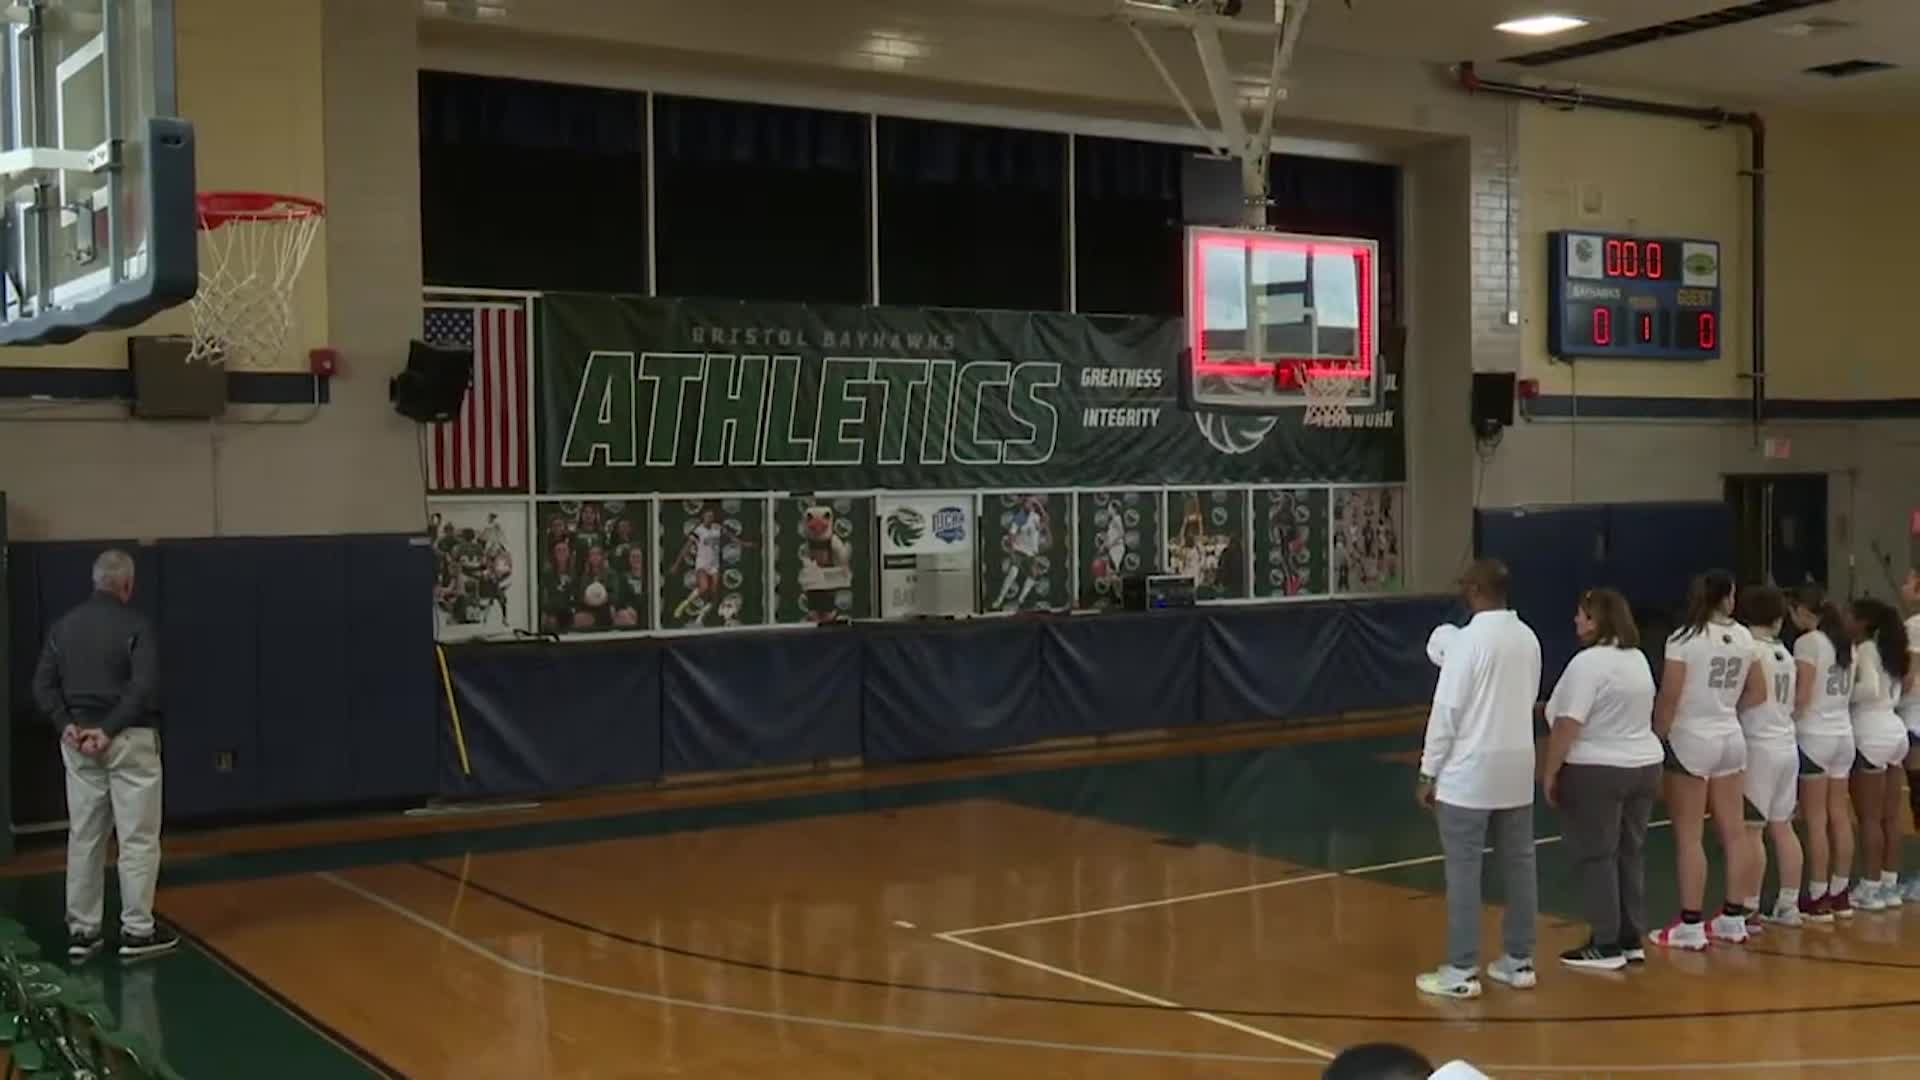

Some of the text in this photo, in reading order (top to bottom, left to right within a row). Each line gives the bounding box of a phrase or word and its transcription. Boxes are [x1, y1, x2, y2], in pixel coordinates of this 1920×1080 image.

[691, 326, 956, 351] BRISTOL BAYHAWKS
[1594, 307, 1610, 345] 0
[1700, 314, 1715, 348] 0
[1081, 367, 1162, 389] GREATNESS
[562, 350, 1062, 467] ATHLETICS
[1082, 407, 1161, 429] INTEGRITY
[1708, 656, 1742, 689] 22
[1825, 664, 1850, 696] 20
